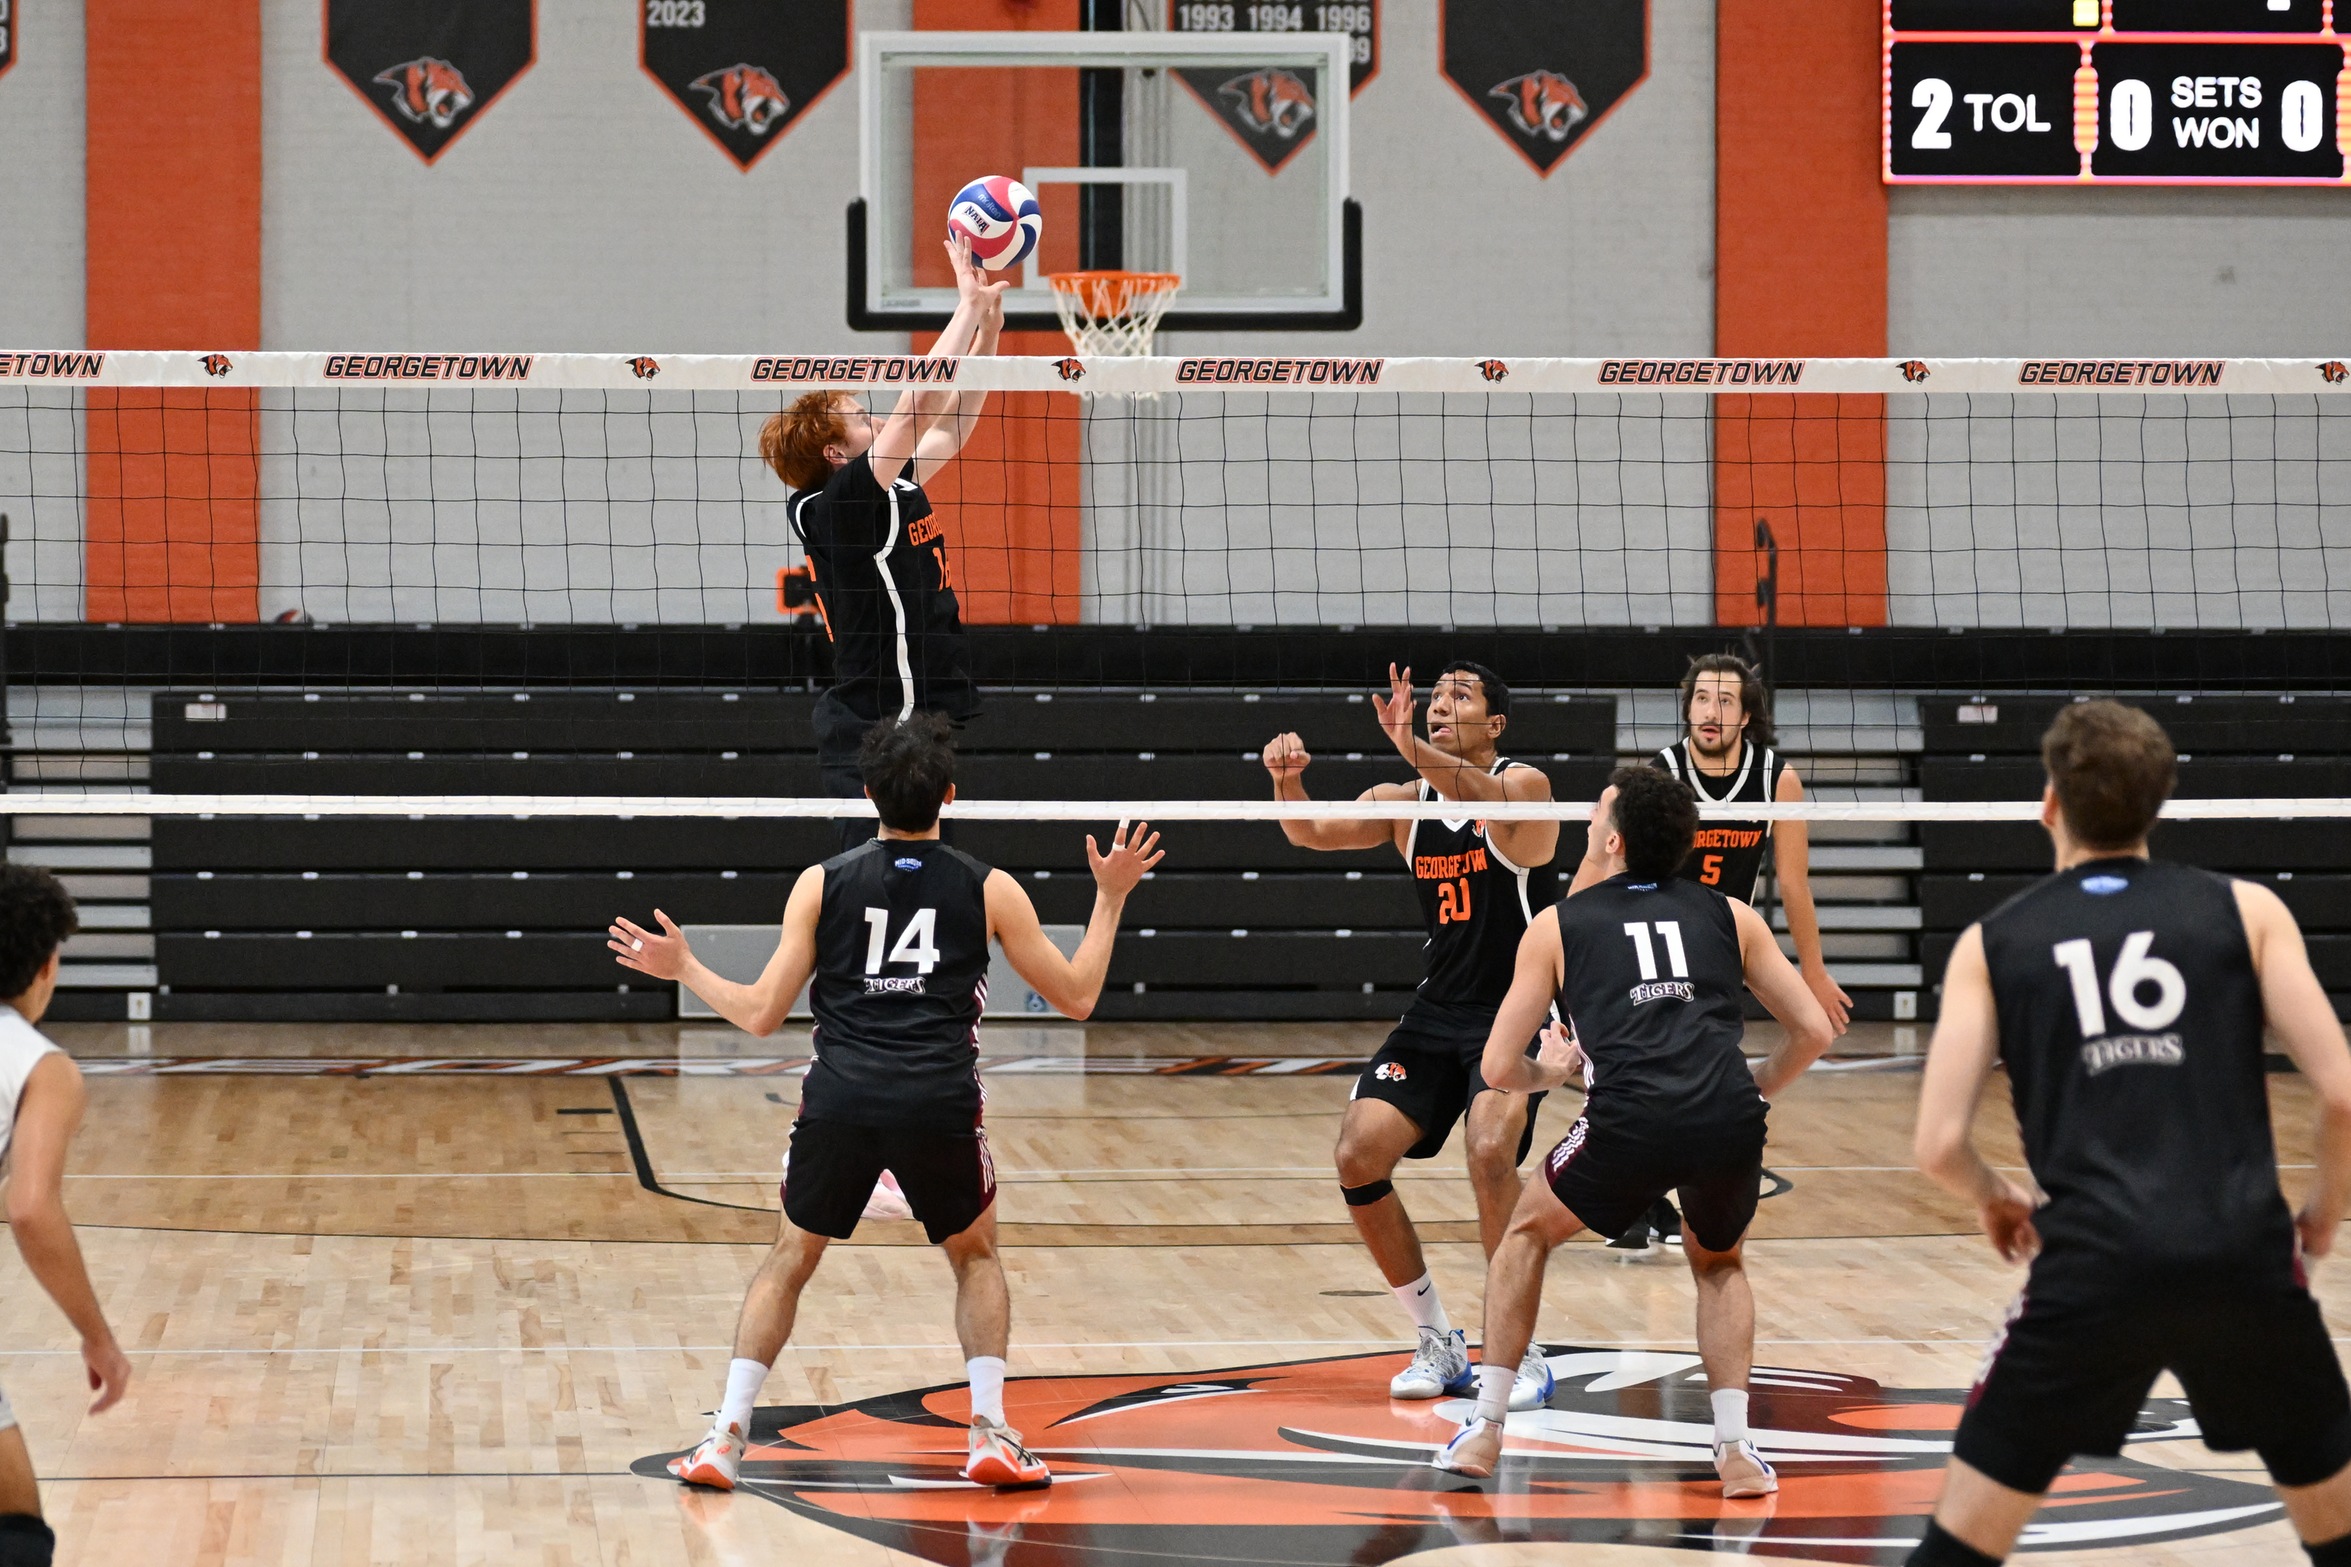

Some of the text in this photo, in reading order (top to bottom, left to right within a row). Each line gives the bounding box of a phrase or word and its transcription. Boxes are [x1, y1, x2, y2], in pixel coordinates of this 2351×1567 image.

[647, 0, 706, 27] 2023
[1178, 4, 1371, 33] 1993 1994 1996
[2171, 76, 2262, 108] SETS
[1911, 78, 2051, 149] 2 TOL
[2110, 79, 2153, 151] 0
[2281, 80, 2323, 152] 0
[2173, 117, 2260, 149] WON
[963, 205, 990, 236] NAIA
[323, 354, 534, 380] GEORGETOWN
[751, 357, 960, 382] GEORGETOWN
[1175, 358, 1384, 384] GEORGETOWN
[1597, 359, 1805, 385] GEORGETOWN
[2018, 360, 2225, 386] GEORGETOWN
[1700, 854, 1723, 885] 5
[1438, 877, 1471, 925] 20
[864, 907, 940, 974] 14
[1623, 921, 1689, 980] 11
[864, 976, 926, 994] TIGERS
[1630, 982, 1695, 1006] TIGERS
[2053, 931, 2187, 1037] 16
[2082, 1032, 2186, 1077] TIGERS
